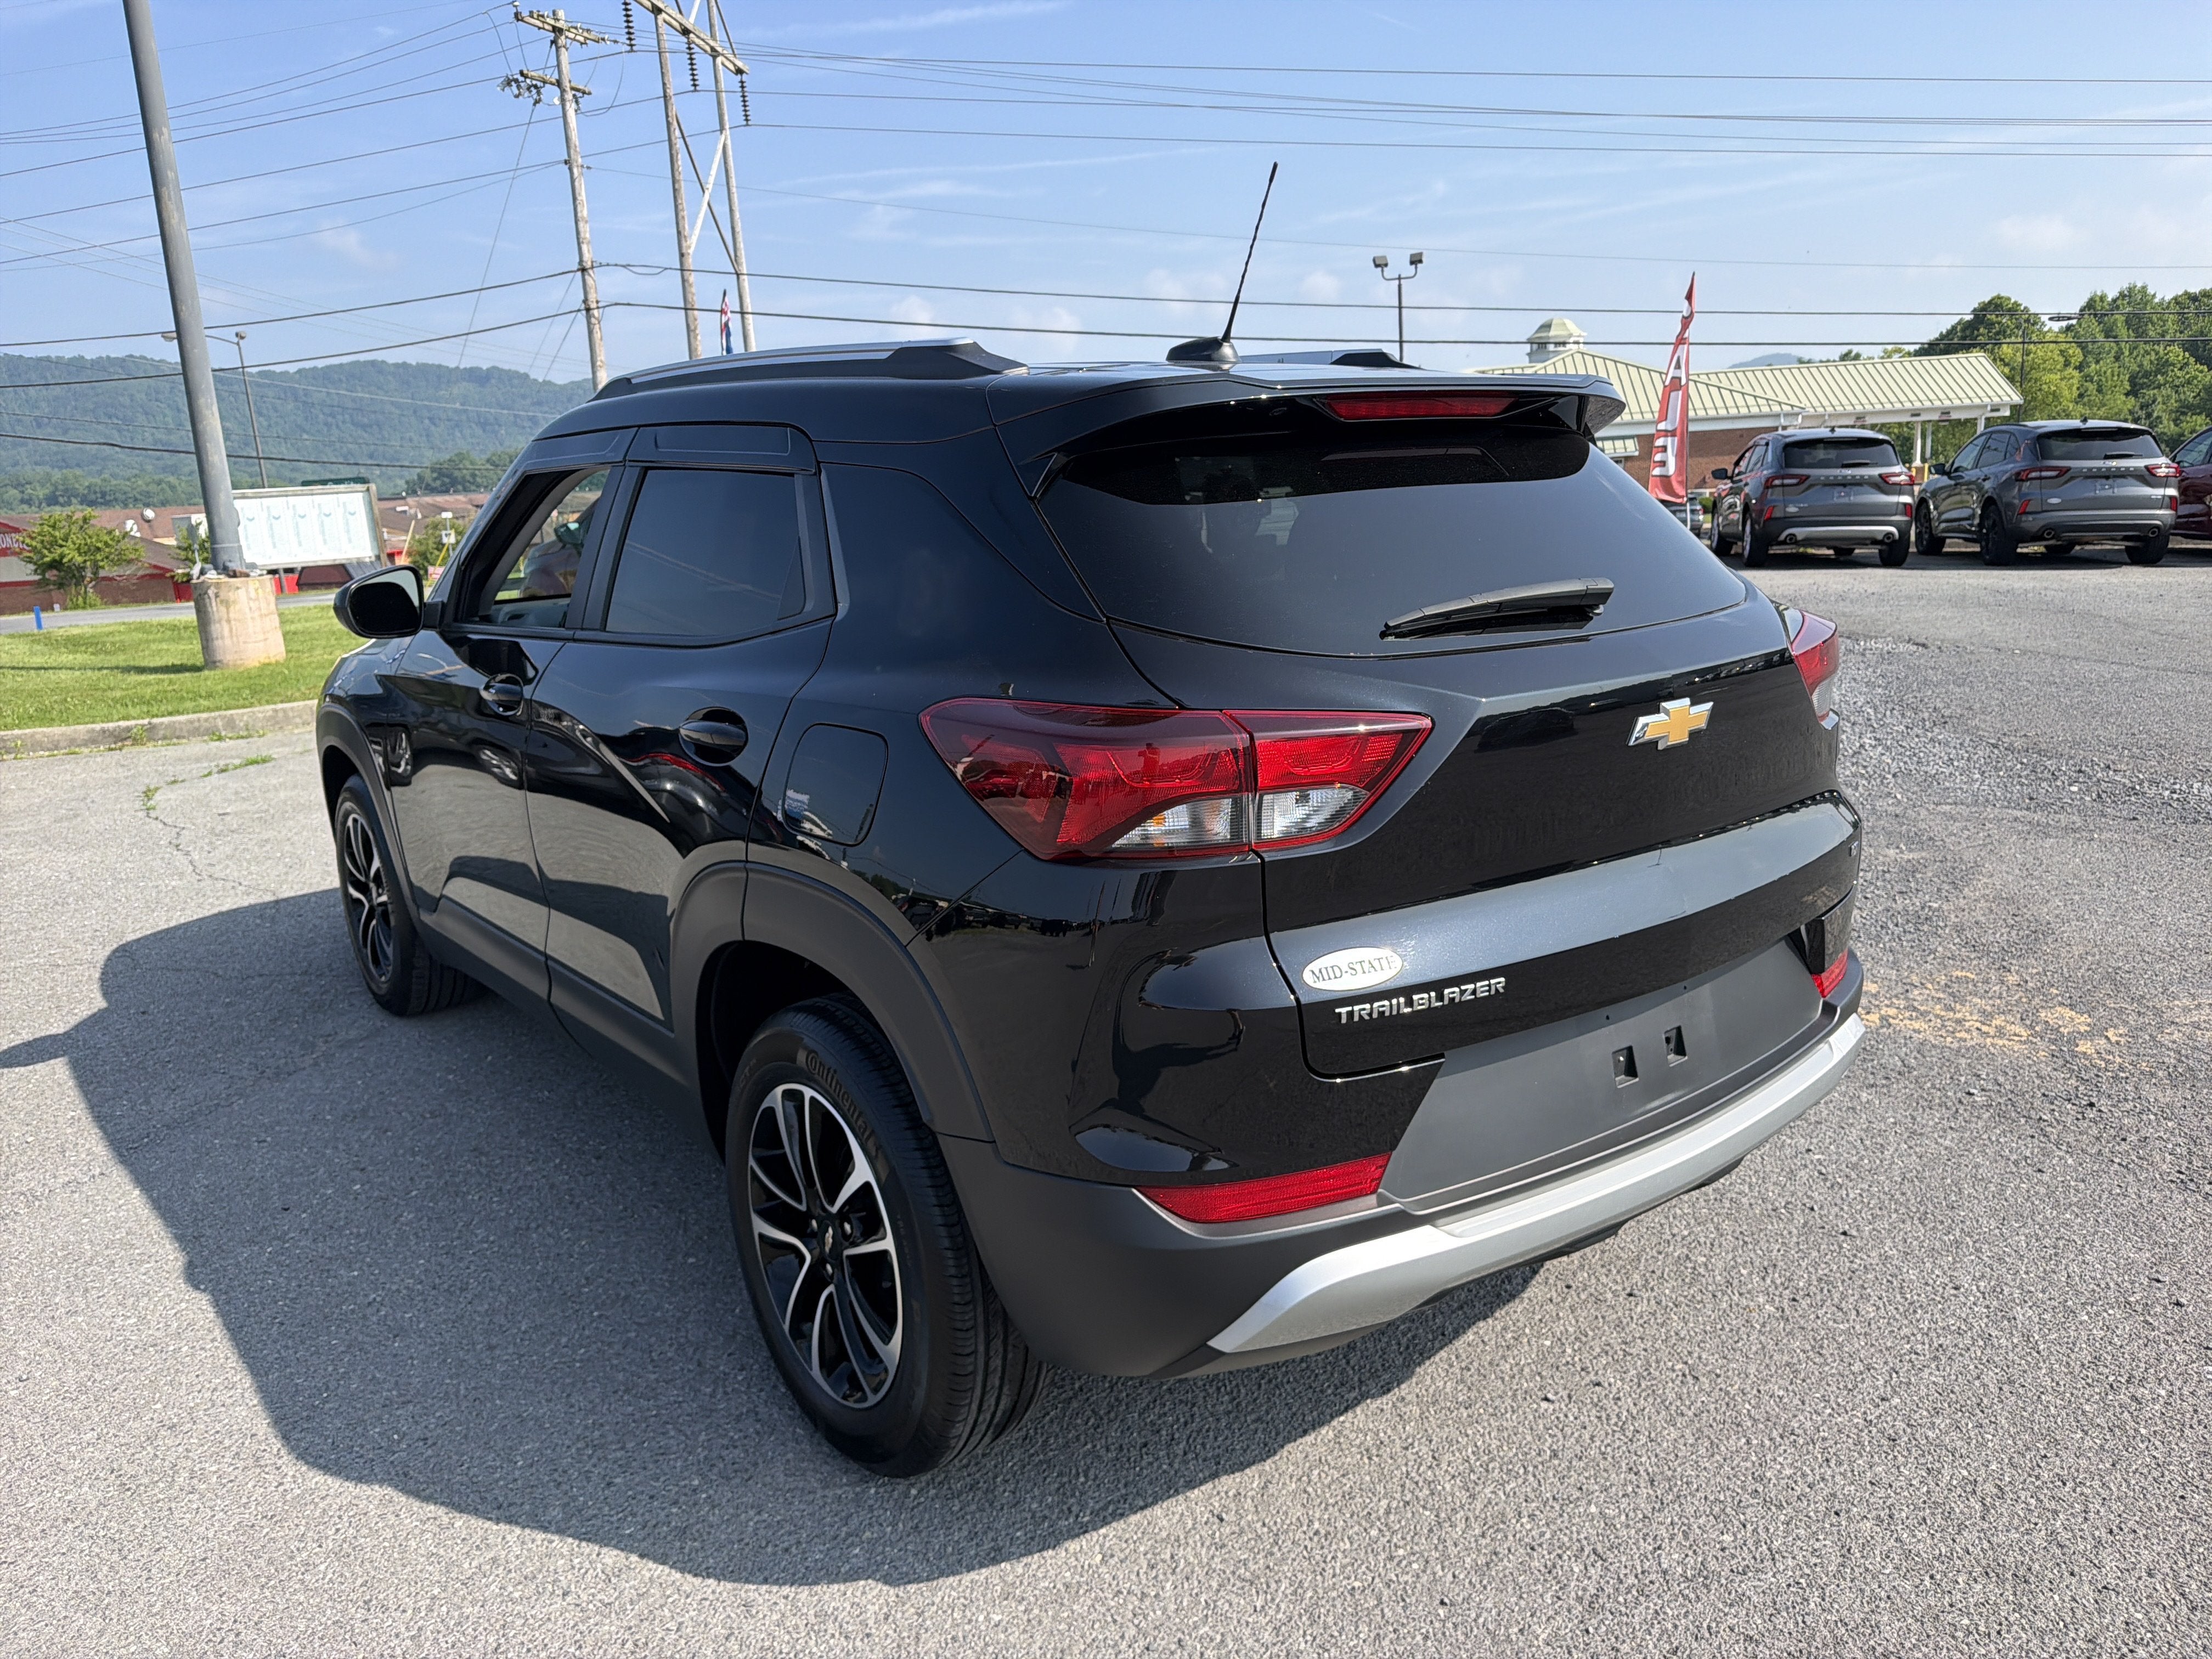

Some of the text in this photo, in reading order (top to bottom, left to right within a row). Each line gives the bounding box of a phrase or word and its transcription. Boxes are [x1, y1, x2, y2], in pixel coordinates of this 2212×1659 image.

[1309, 956, 1397, 984] MID-STATE
[1335, 977, 1505, 1024] TRAILBLAZER
[806, 1049, 876, 1143] Continental
